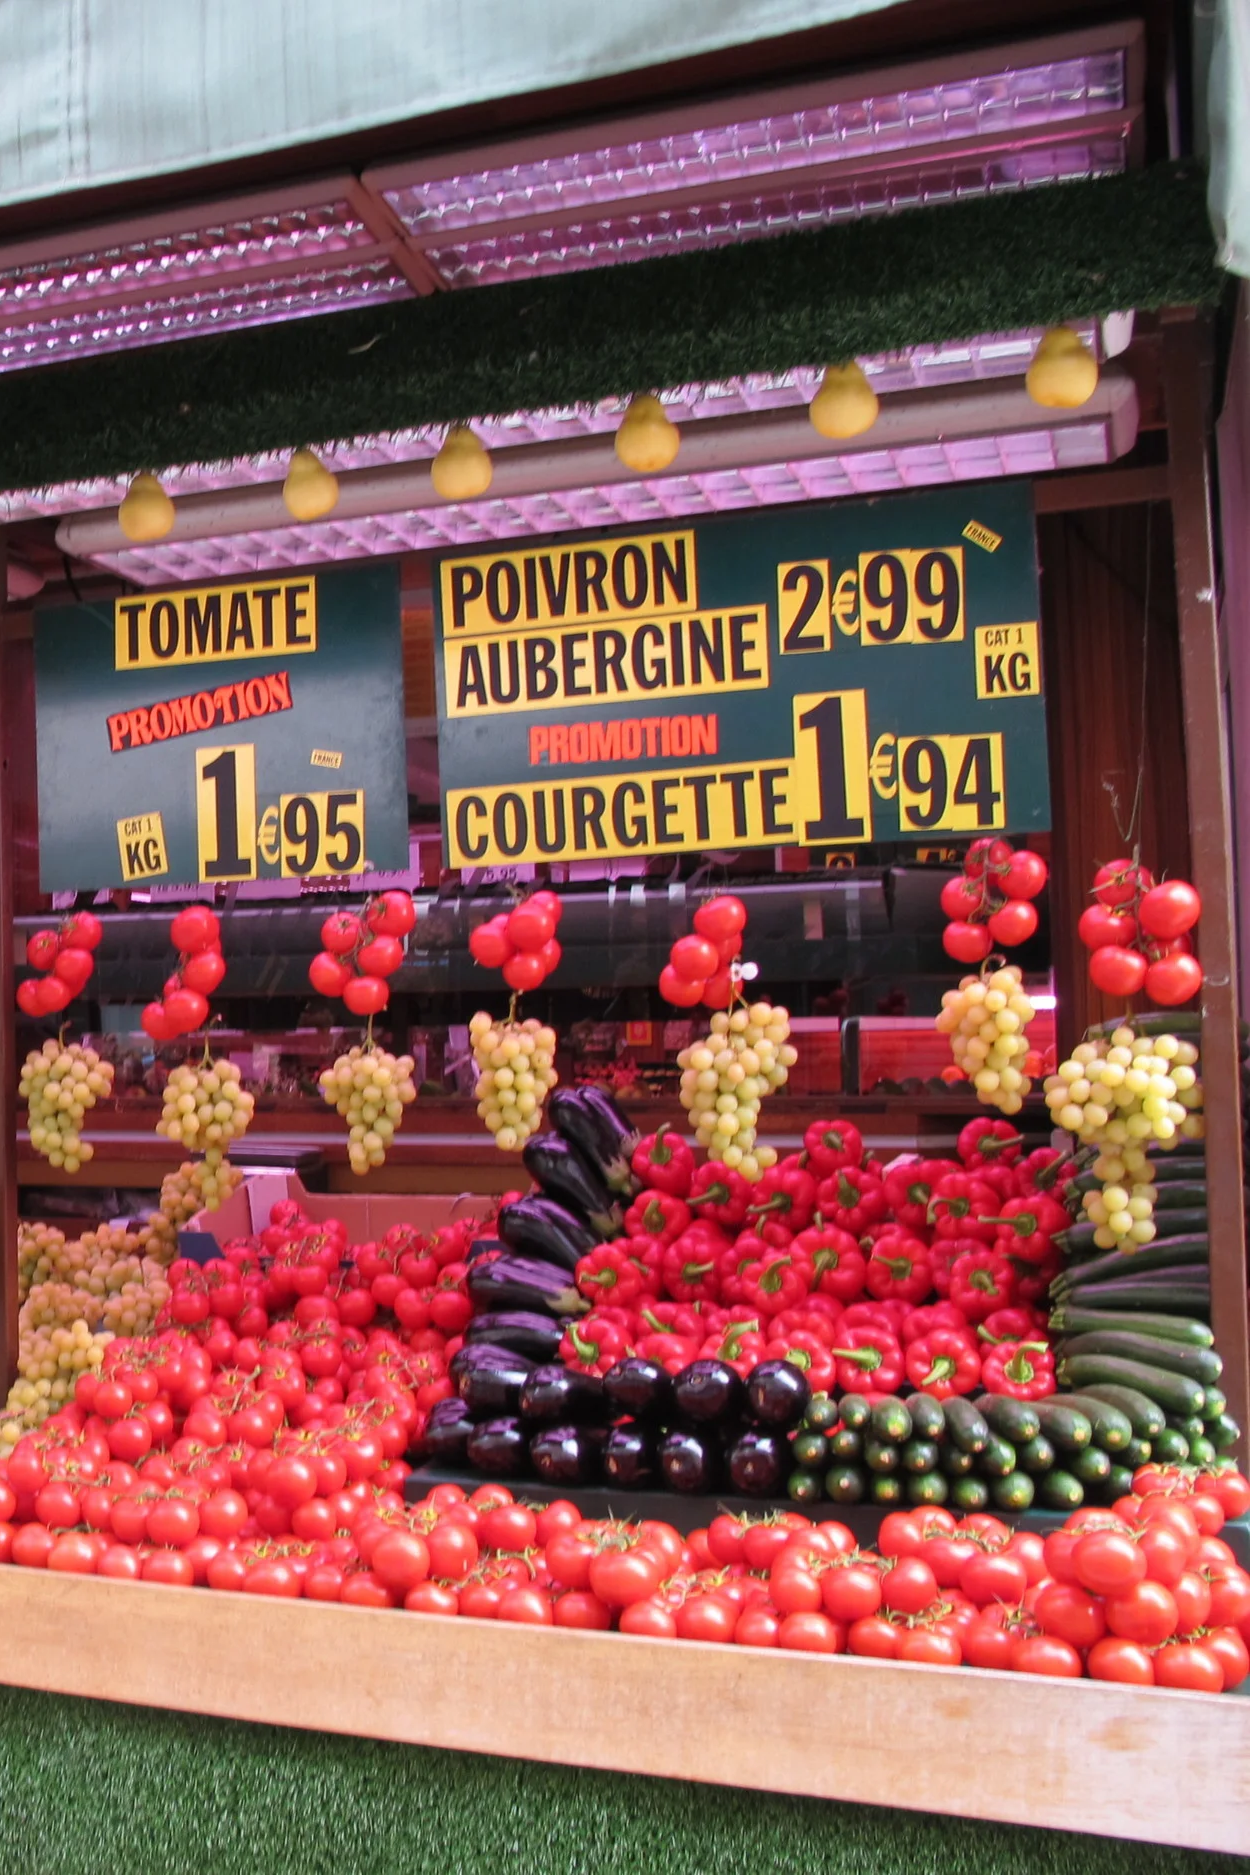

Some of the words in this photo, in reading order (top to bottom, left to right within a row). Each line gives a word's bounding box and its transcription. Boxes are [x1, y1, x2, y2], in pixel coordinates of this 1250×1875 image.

[967, 525, 997, 548] FRANCE
[450, 539, 688, 629] POIVRON
[119, 585, 311, 663] TOMATE
[985, 629, 1010, 647] CAT
[1015, 627, 1023, 645] 1
[456, 614, 763, 709] AUBERGINE
[984, 652, 1031, 695] KG
[107, 672, 292, 751] PROMOTION
[529, 714, 718, 766] PROMOTION
[124, 819, 142, 837] CAT
[455, 767, 794, 860] COURGETTE
[126, 838, 161, 876] KG
